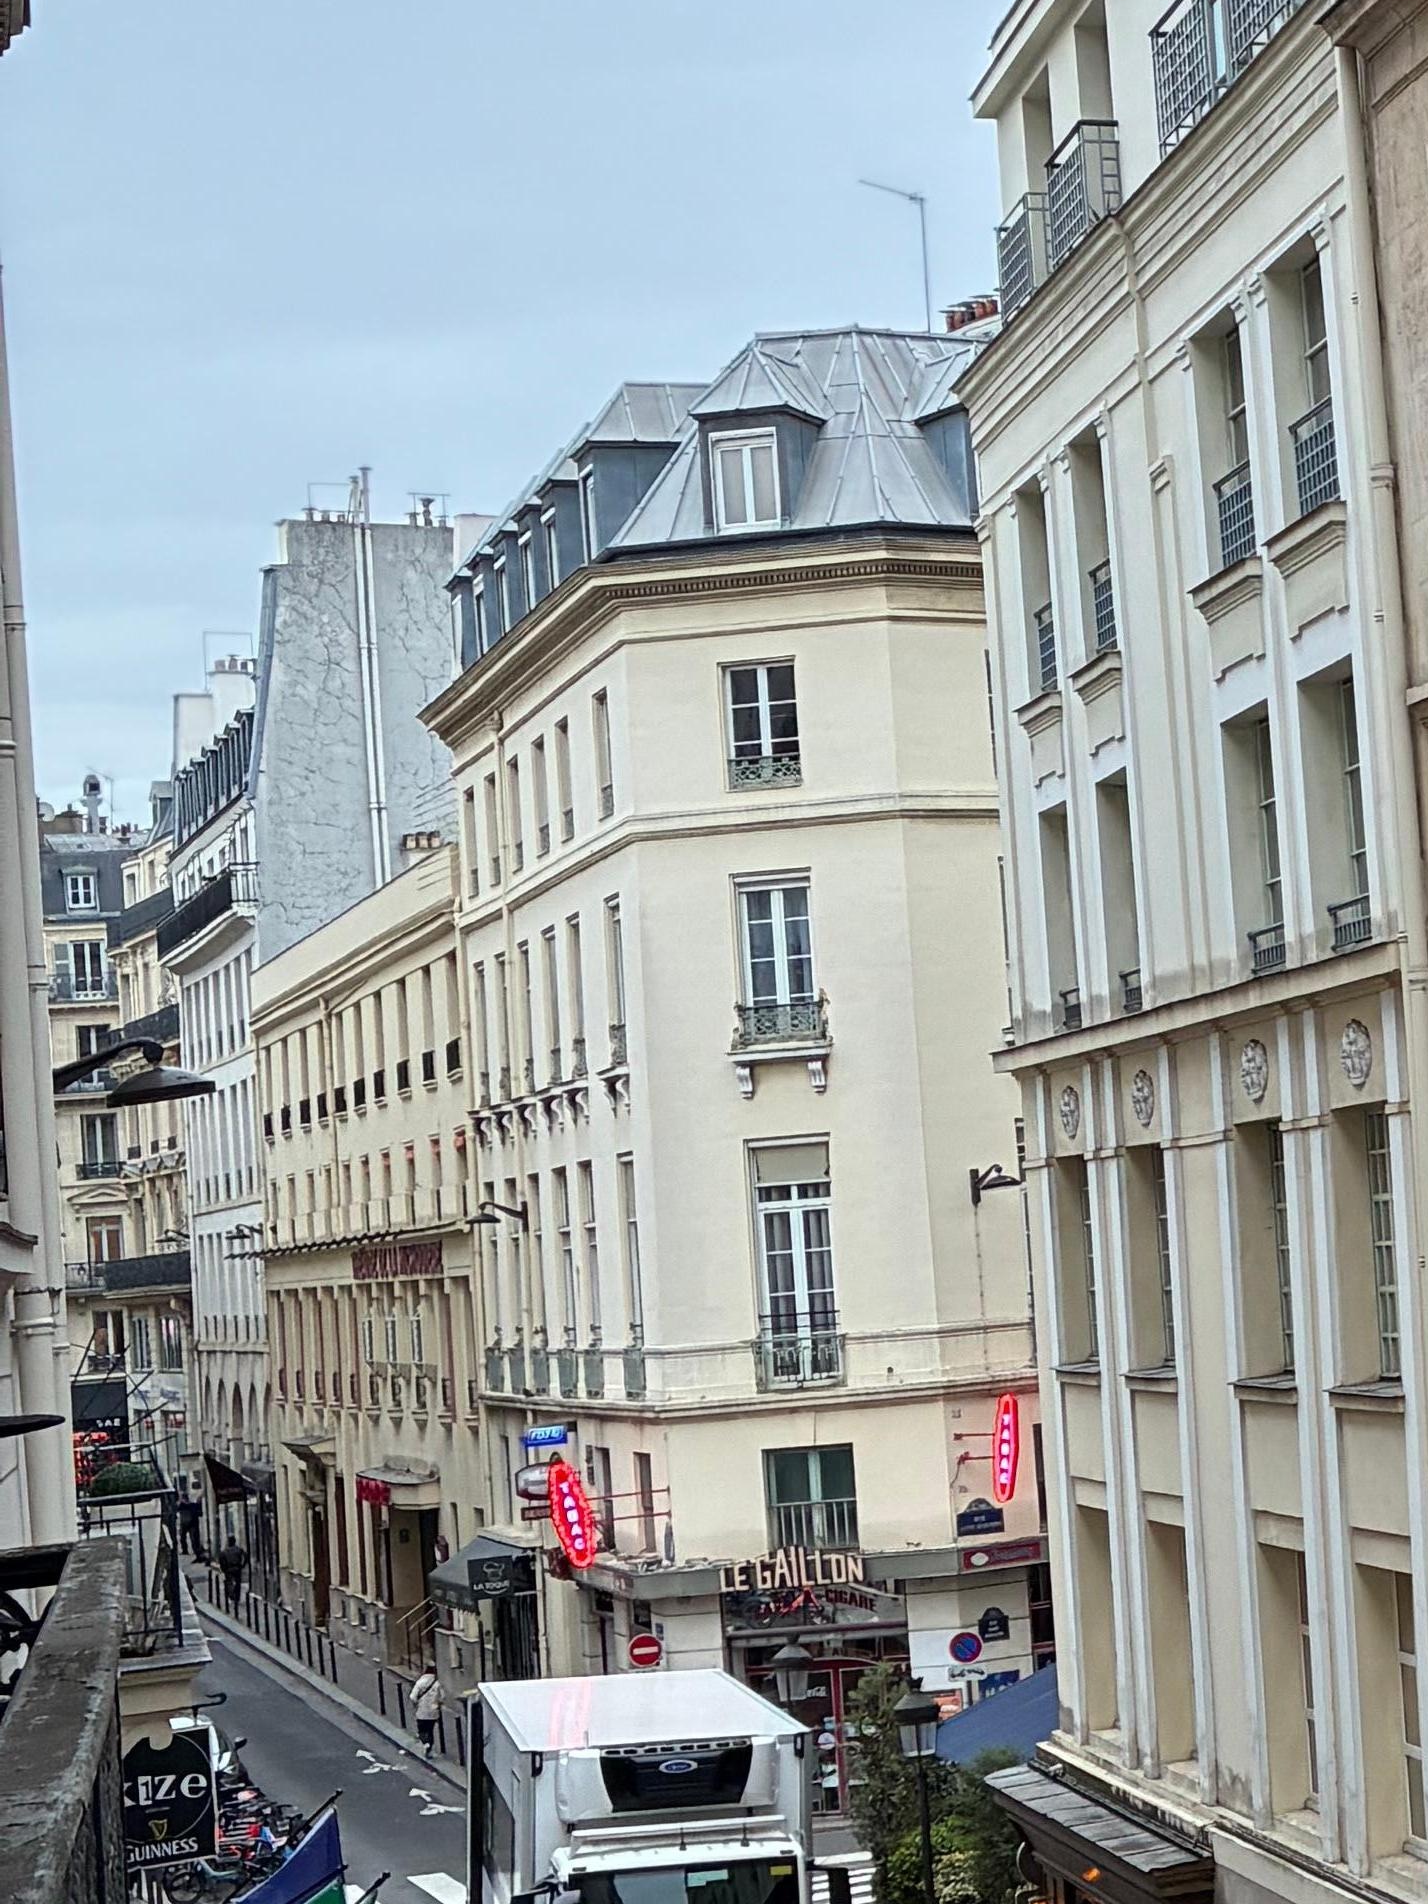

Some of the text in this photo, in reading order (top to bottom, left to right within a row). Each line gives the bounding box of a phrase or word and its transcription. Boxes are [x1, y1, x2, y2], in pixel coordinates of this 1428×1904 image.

[999, 1413, 1011, 1484] TABAC
[559, 1480, 586, 1550] TABAC
[719, 1546, 865, 1592] LE GAILLON
